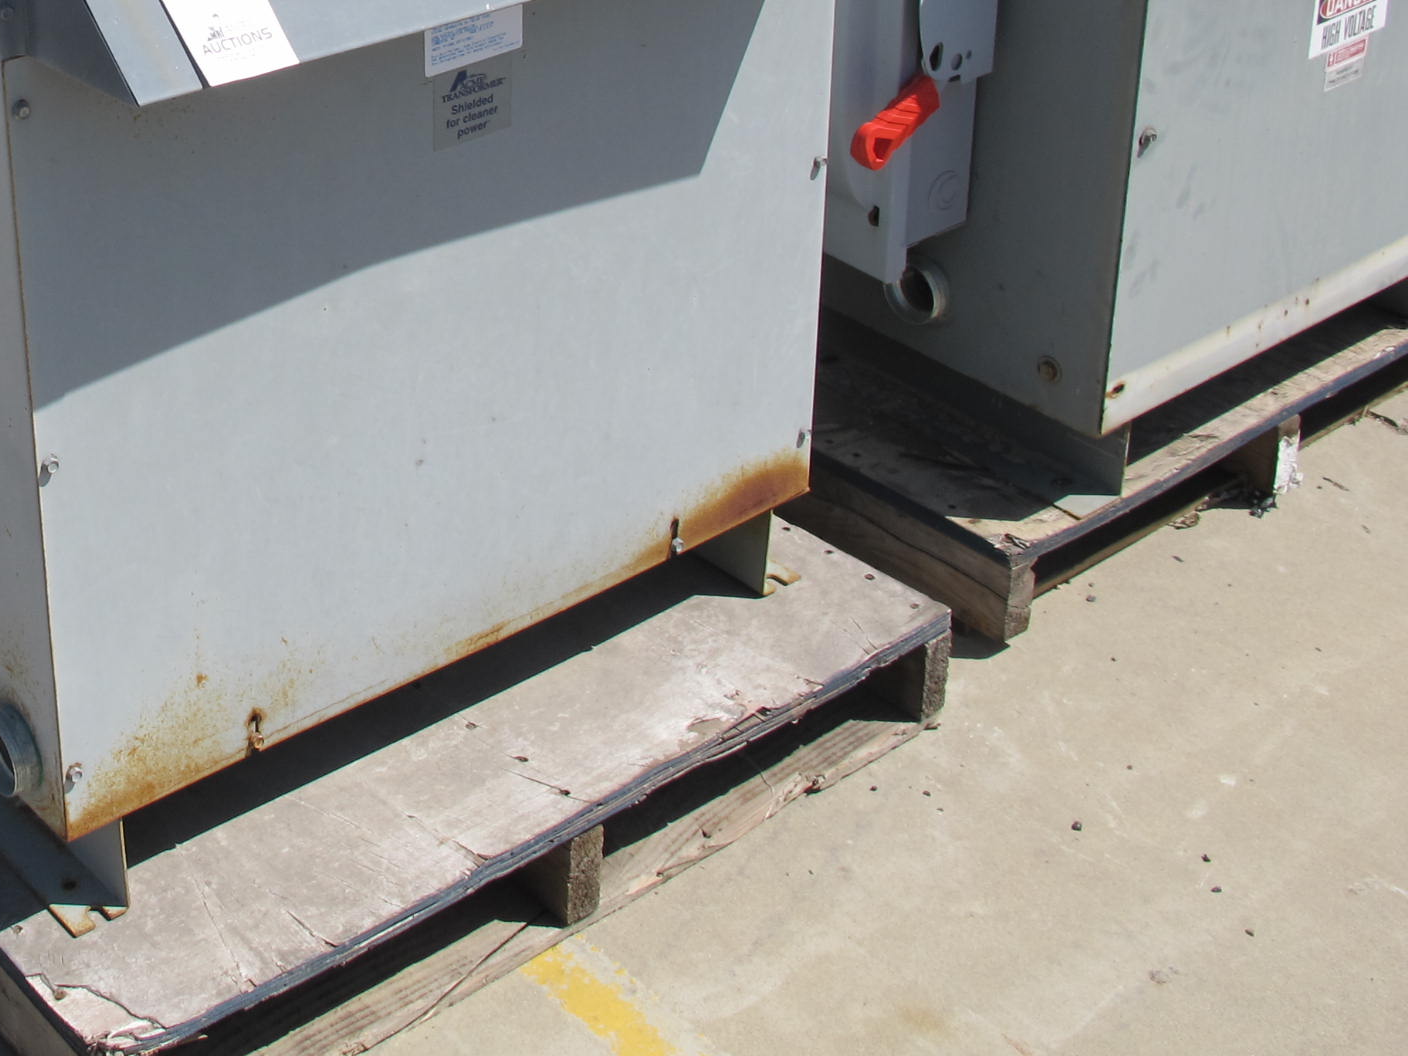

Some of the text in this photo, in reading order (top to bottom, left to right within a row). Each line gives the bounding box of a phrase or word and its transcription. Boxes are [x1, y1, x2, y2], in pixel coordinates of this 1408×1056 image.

[1321, 5, 1377, 50] HIGH VOLTAGE
[202, 27, 273, 56] AUCTIONS
[451, 93, 494, 115] Shielded
[446, 105, 498, 129] for cleaner
[457, 120, 488, 140] power
